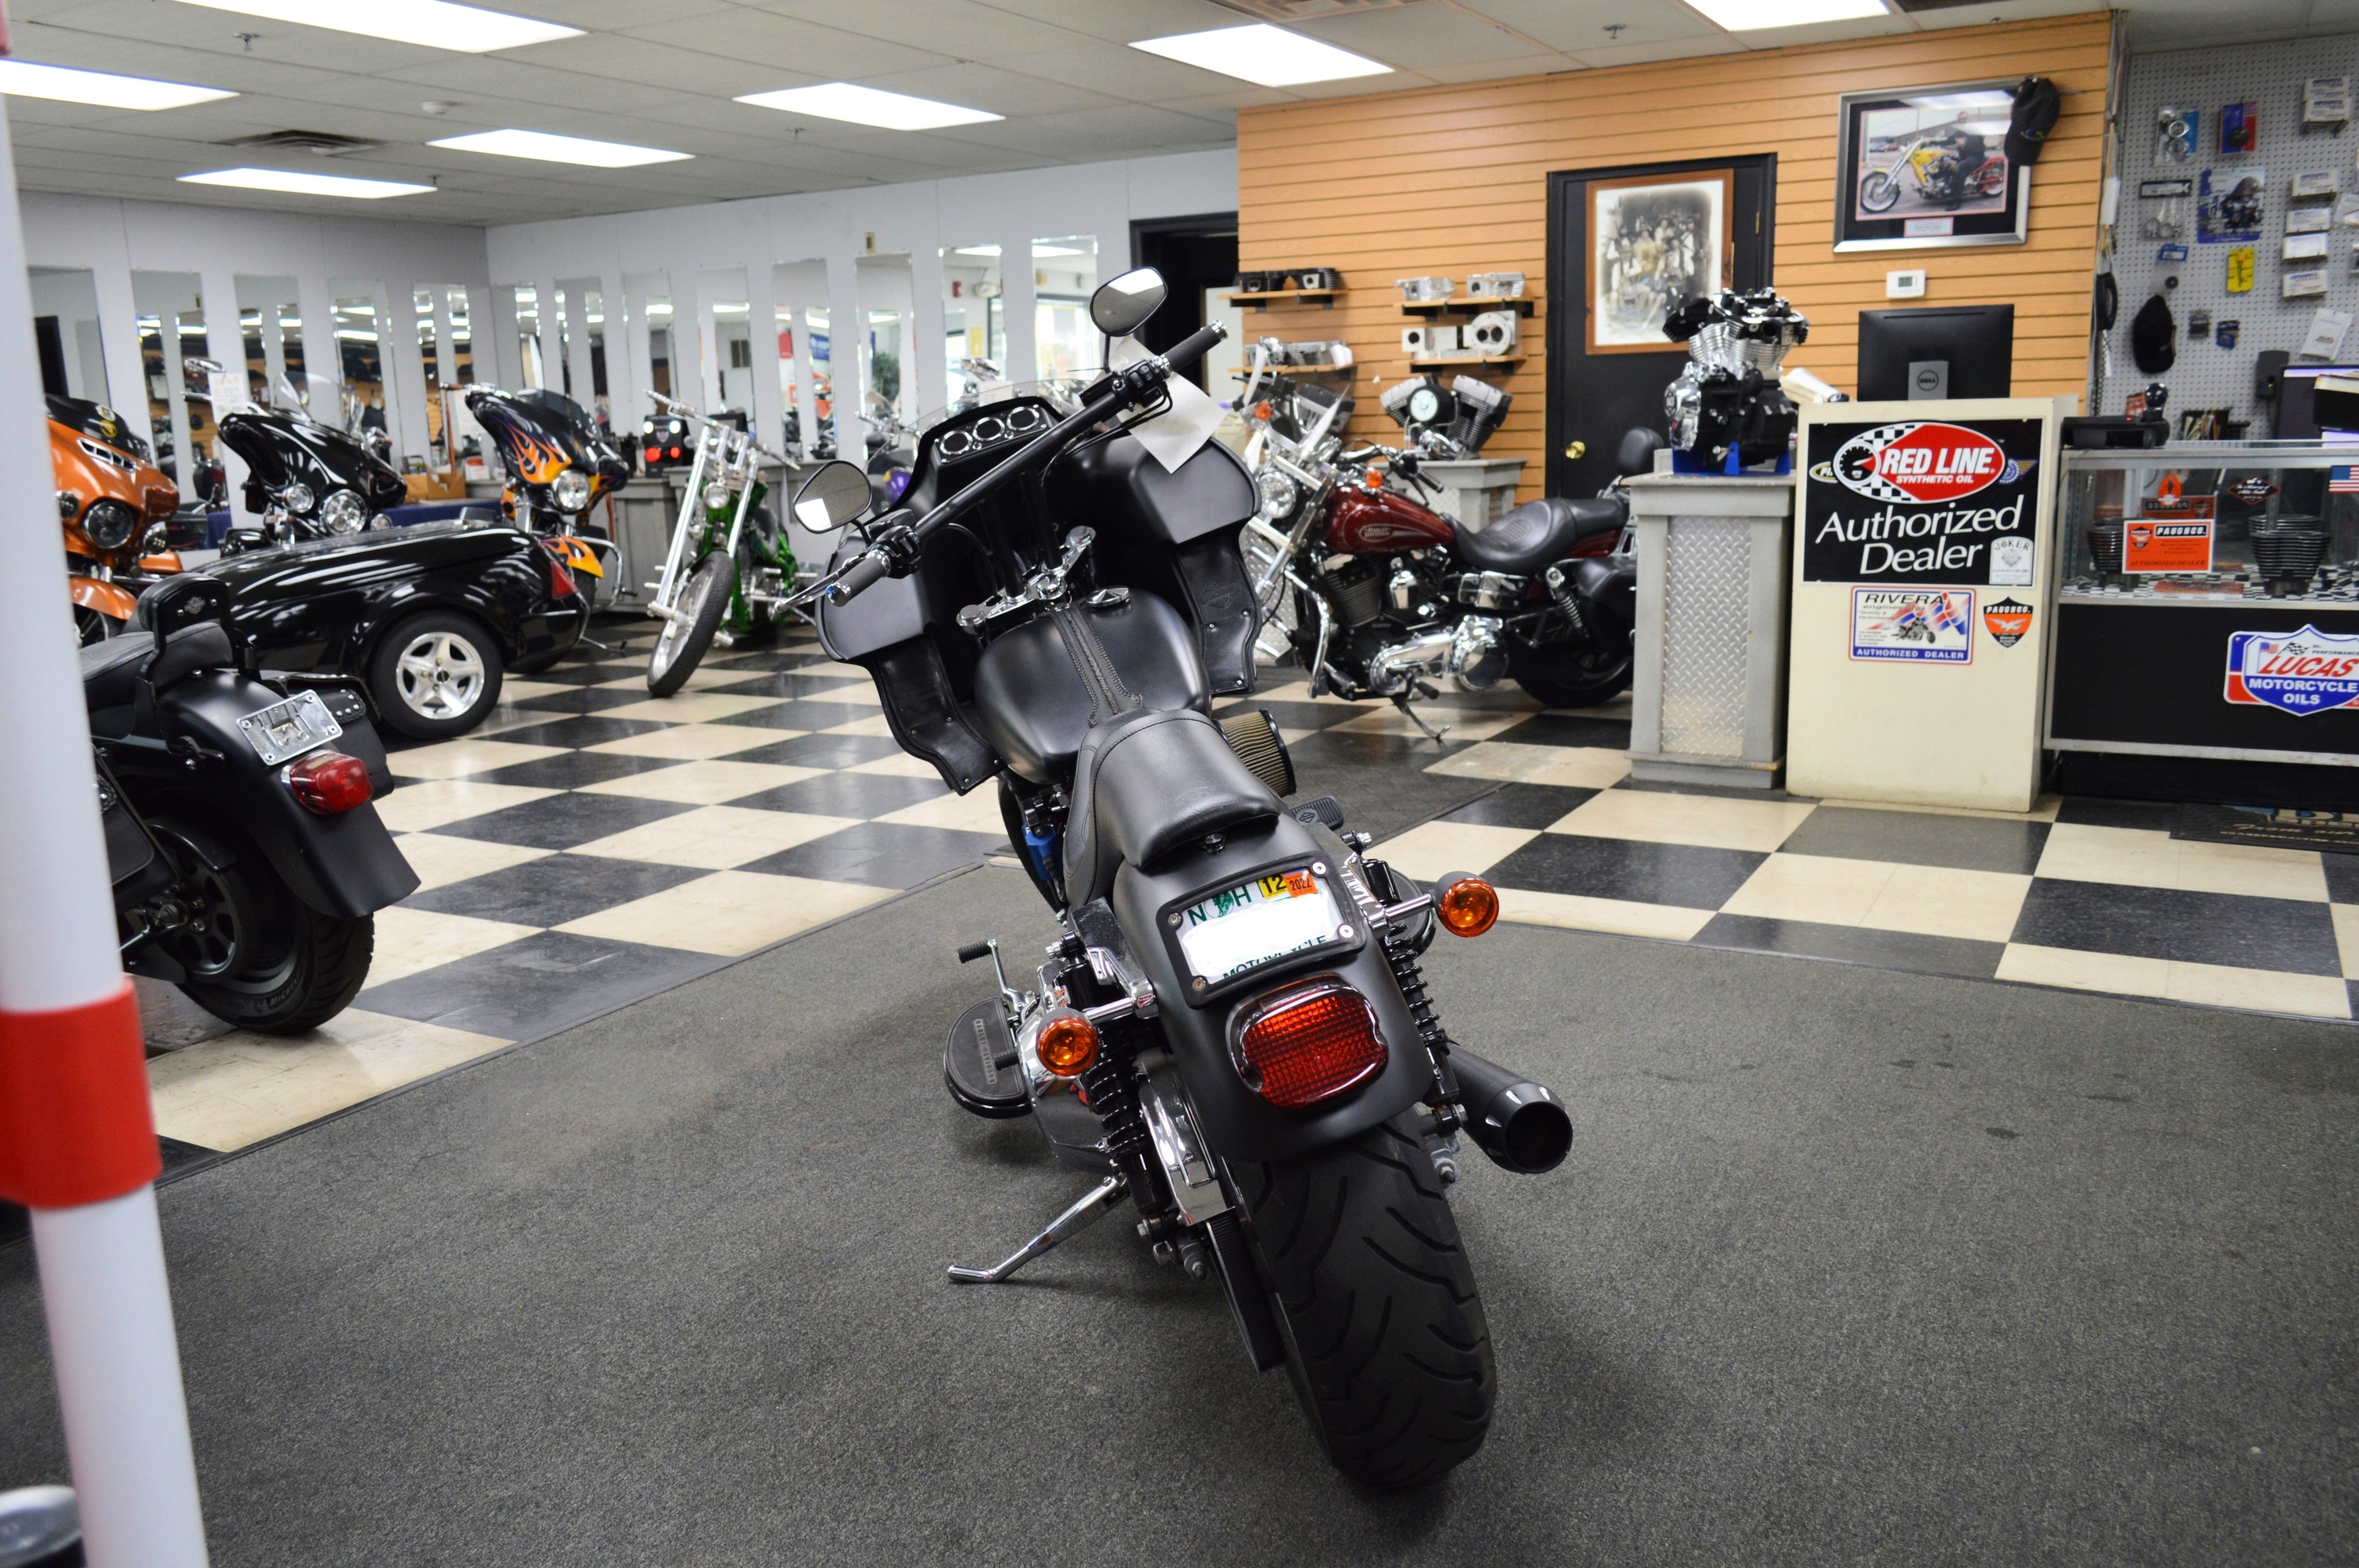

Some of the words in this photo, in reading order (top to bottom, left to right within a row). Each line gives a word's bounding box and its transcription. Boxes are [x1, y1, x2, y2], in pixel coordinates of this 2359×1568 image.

[1882, 448, 1932, 474] RED
[1936, 448, 1995, 474] LINE
[1896, 475, 1952, 484] SYNTHETIC
[1955, 475, 1974, 484] OIL
[1816, 495, 2024, 544] Authorized
[1995, 540, 2030, 551] JOKER
[1859, 536, 1983, 575] Dealer
[1865, 594, 1943, 604] RIVERA
[1857, 648, 1919, 658] AUTHORIZED
[1925, 651, 1964, 659] DEALER
[2258, 655, 2359, 677] LUCAS
[2249, 678, 2358, 693] MOTORCYCLE
[2283, 693, 2321, 705] OILS
[1262, 874, 1287, 893] 12
[1290, 878, 1312, 891] 2022
